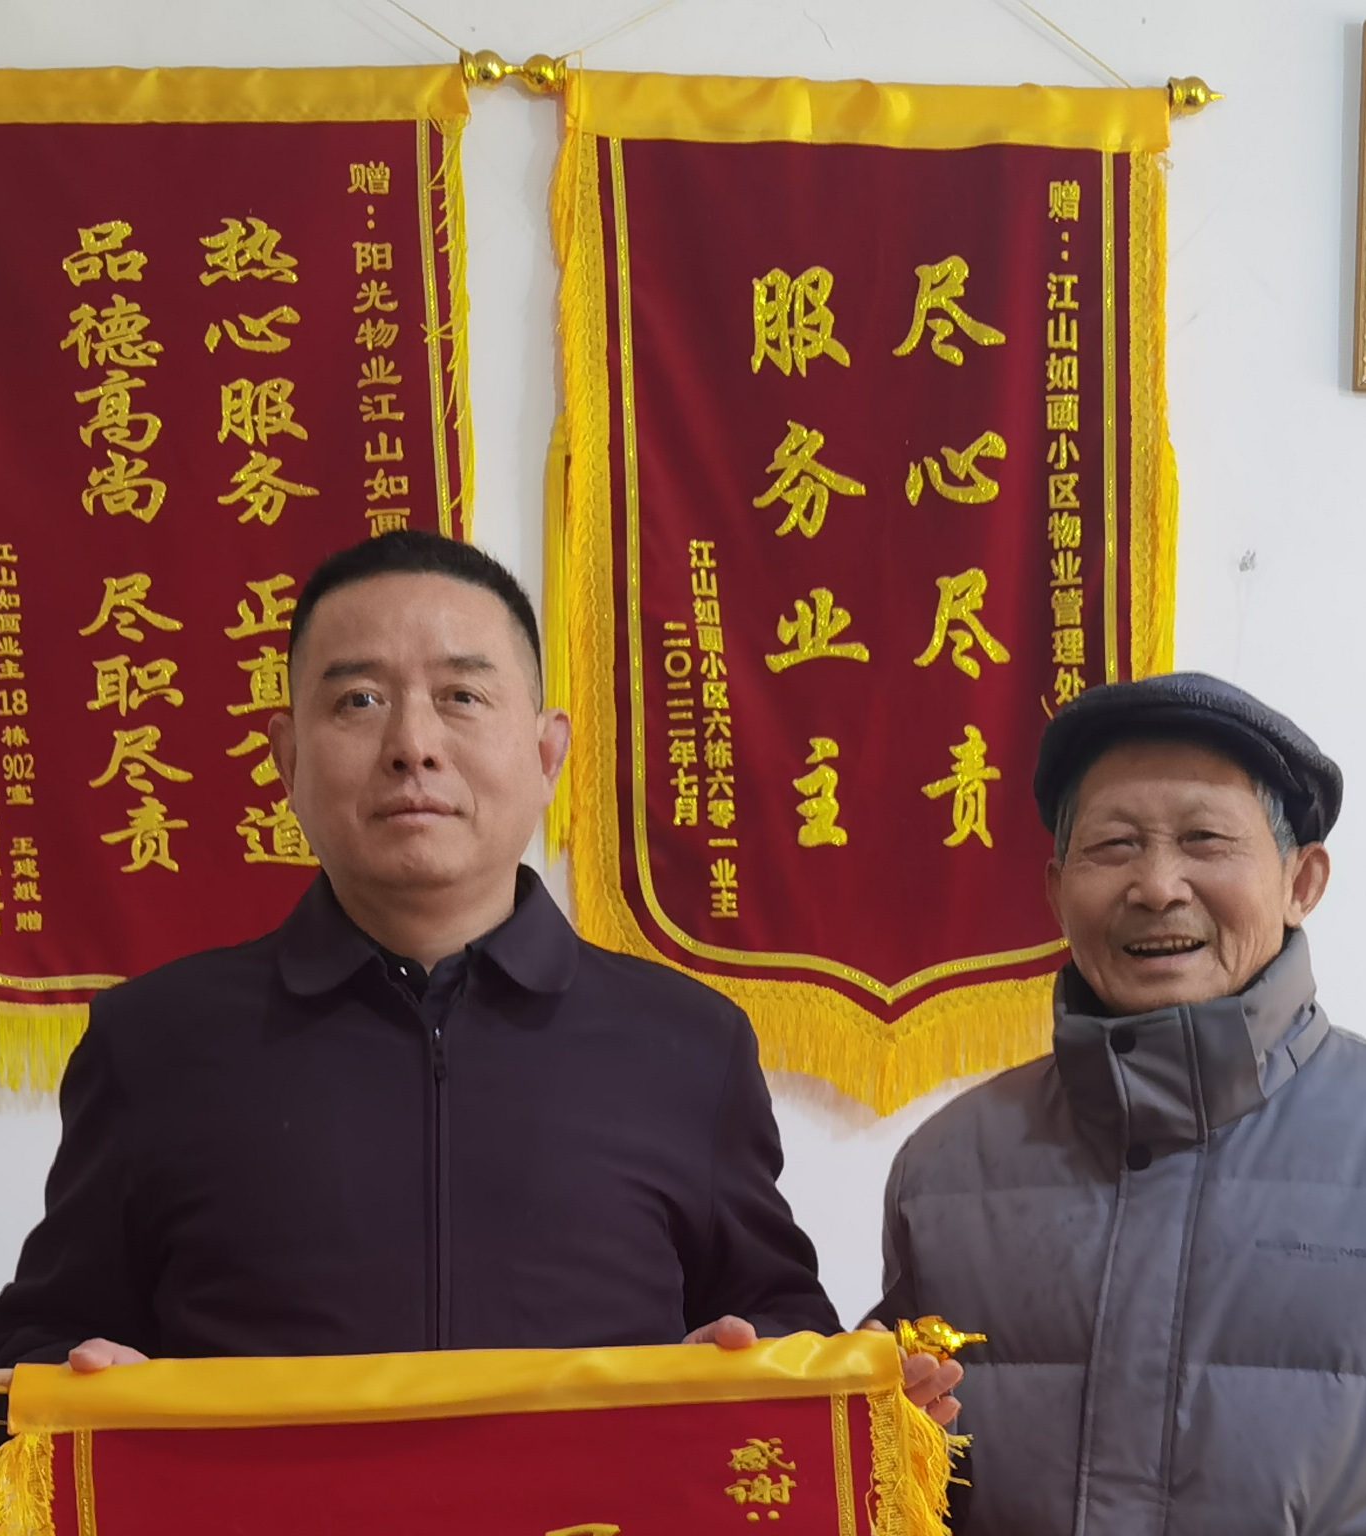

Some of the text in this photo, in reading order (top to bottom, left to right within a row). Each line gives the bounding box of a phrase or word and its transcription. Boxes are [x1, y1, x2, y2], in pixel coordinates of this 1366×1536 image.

[59, 219, 194, 874] 品德高尚 尽职尽责
[199, 217, 320, 526] 热心服务
[750, 266, 871, 849] 服务业主
[893, 254, 1012, 849] 尽心尽责
